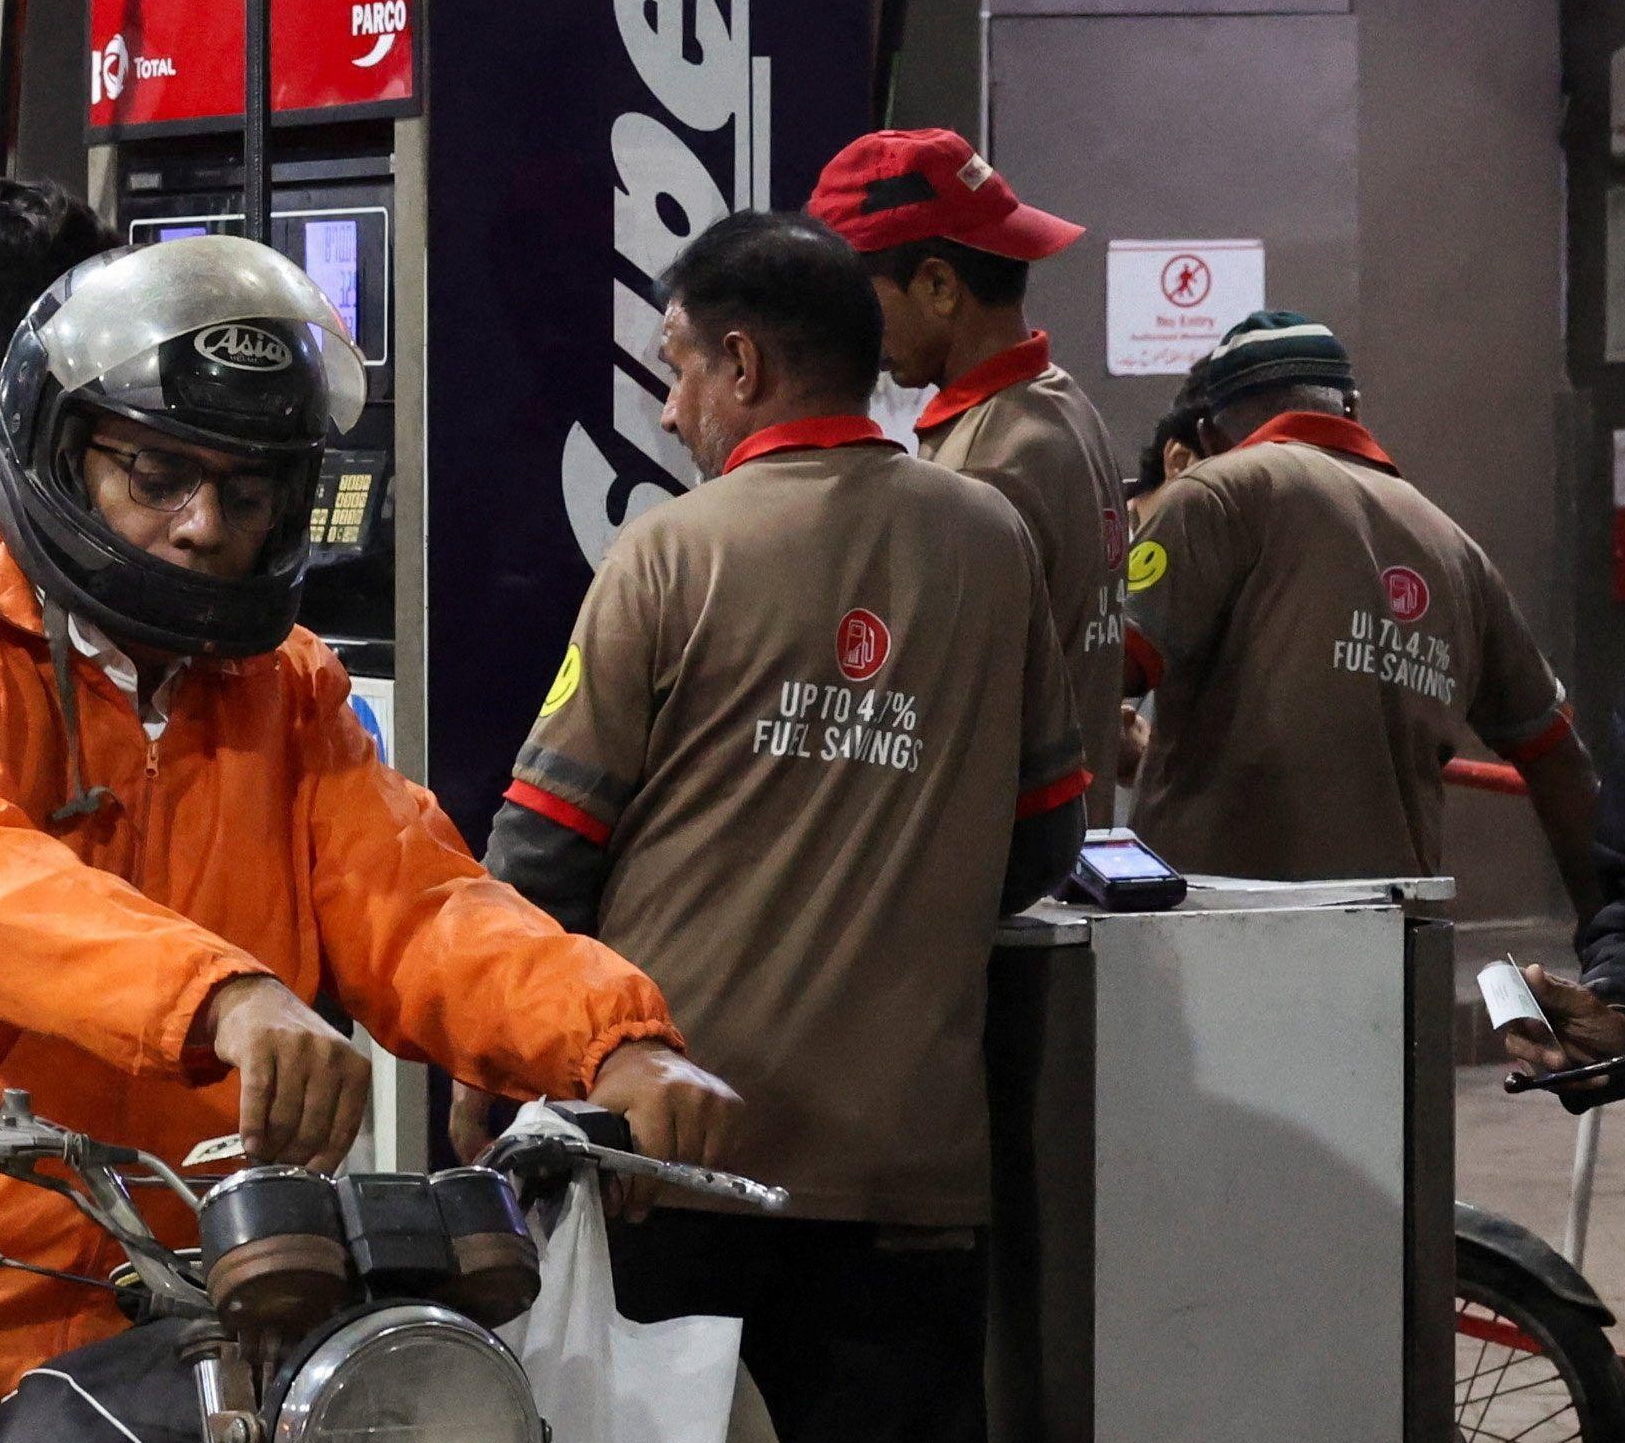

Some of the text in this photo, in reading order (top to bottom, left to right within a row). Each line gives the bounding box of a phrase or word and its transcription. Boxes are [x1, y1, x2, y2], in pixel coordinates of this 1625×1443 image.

[351, 0, 407, 36] PARCO
[133, 56, 177, 80] TOTAL
[1333, 639, 1376, 674] FUE
[779, 680, 818, 719] UP
[819, 684, 851, 723] TO
[752, 719, 811, 758] FUEL
